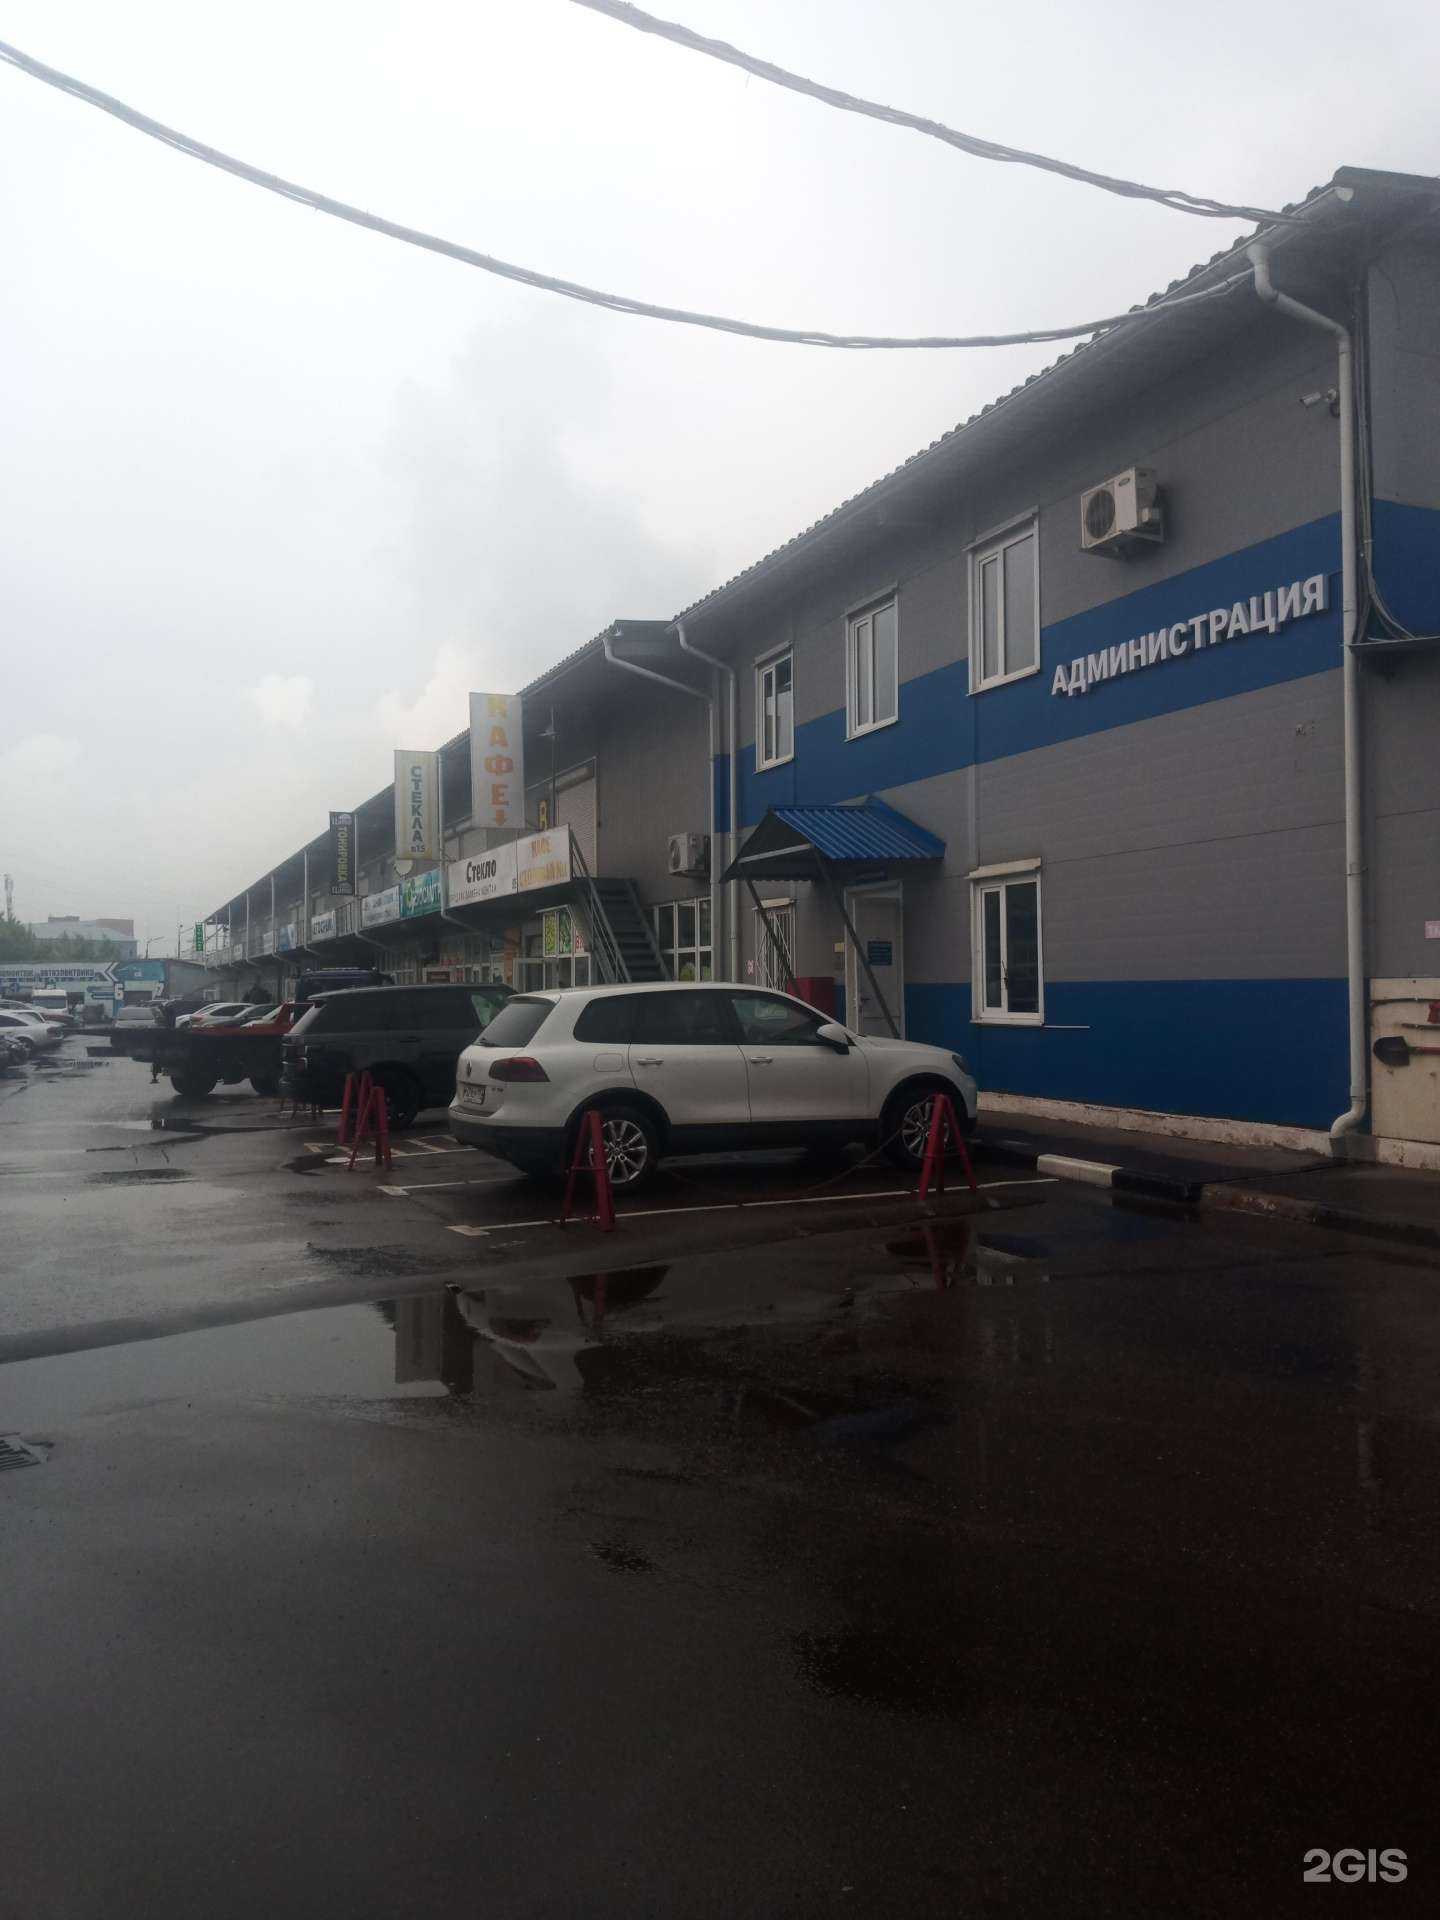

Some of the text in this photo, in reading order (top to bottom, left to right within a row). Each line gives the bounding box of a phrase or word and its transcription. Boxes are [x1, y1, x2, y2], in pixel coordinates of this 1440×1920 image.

[1051, 573, 1325, 697] АДМИНИСТРАЦИЯ
[484, 696, 512, 805] КАФЕ
[410, 766, 423, 842] СТЕКЛА
[466, 859, 497, 883] Стекло
